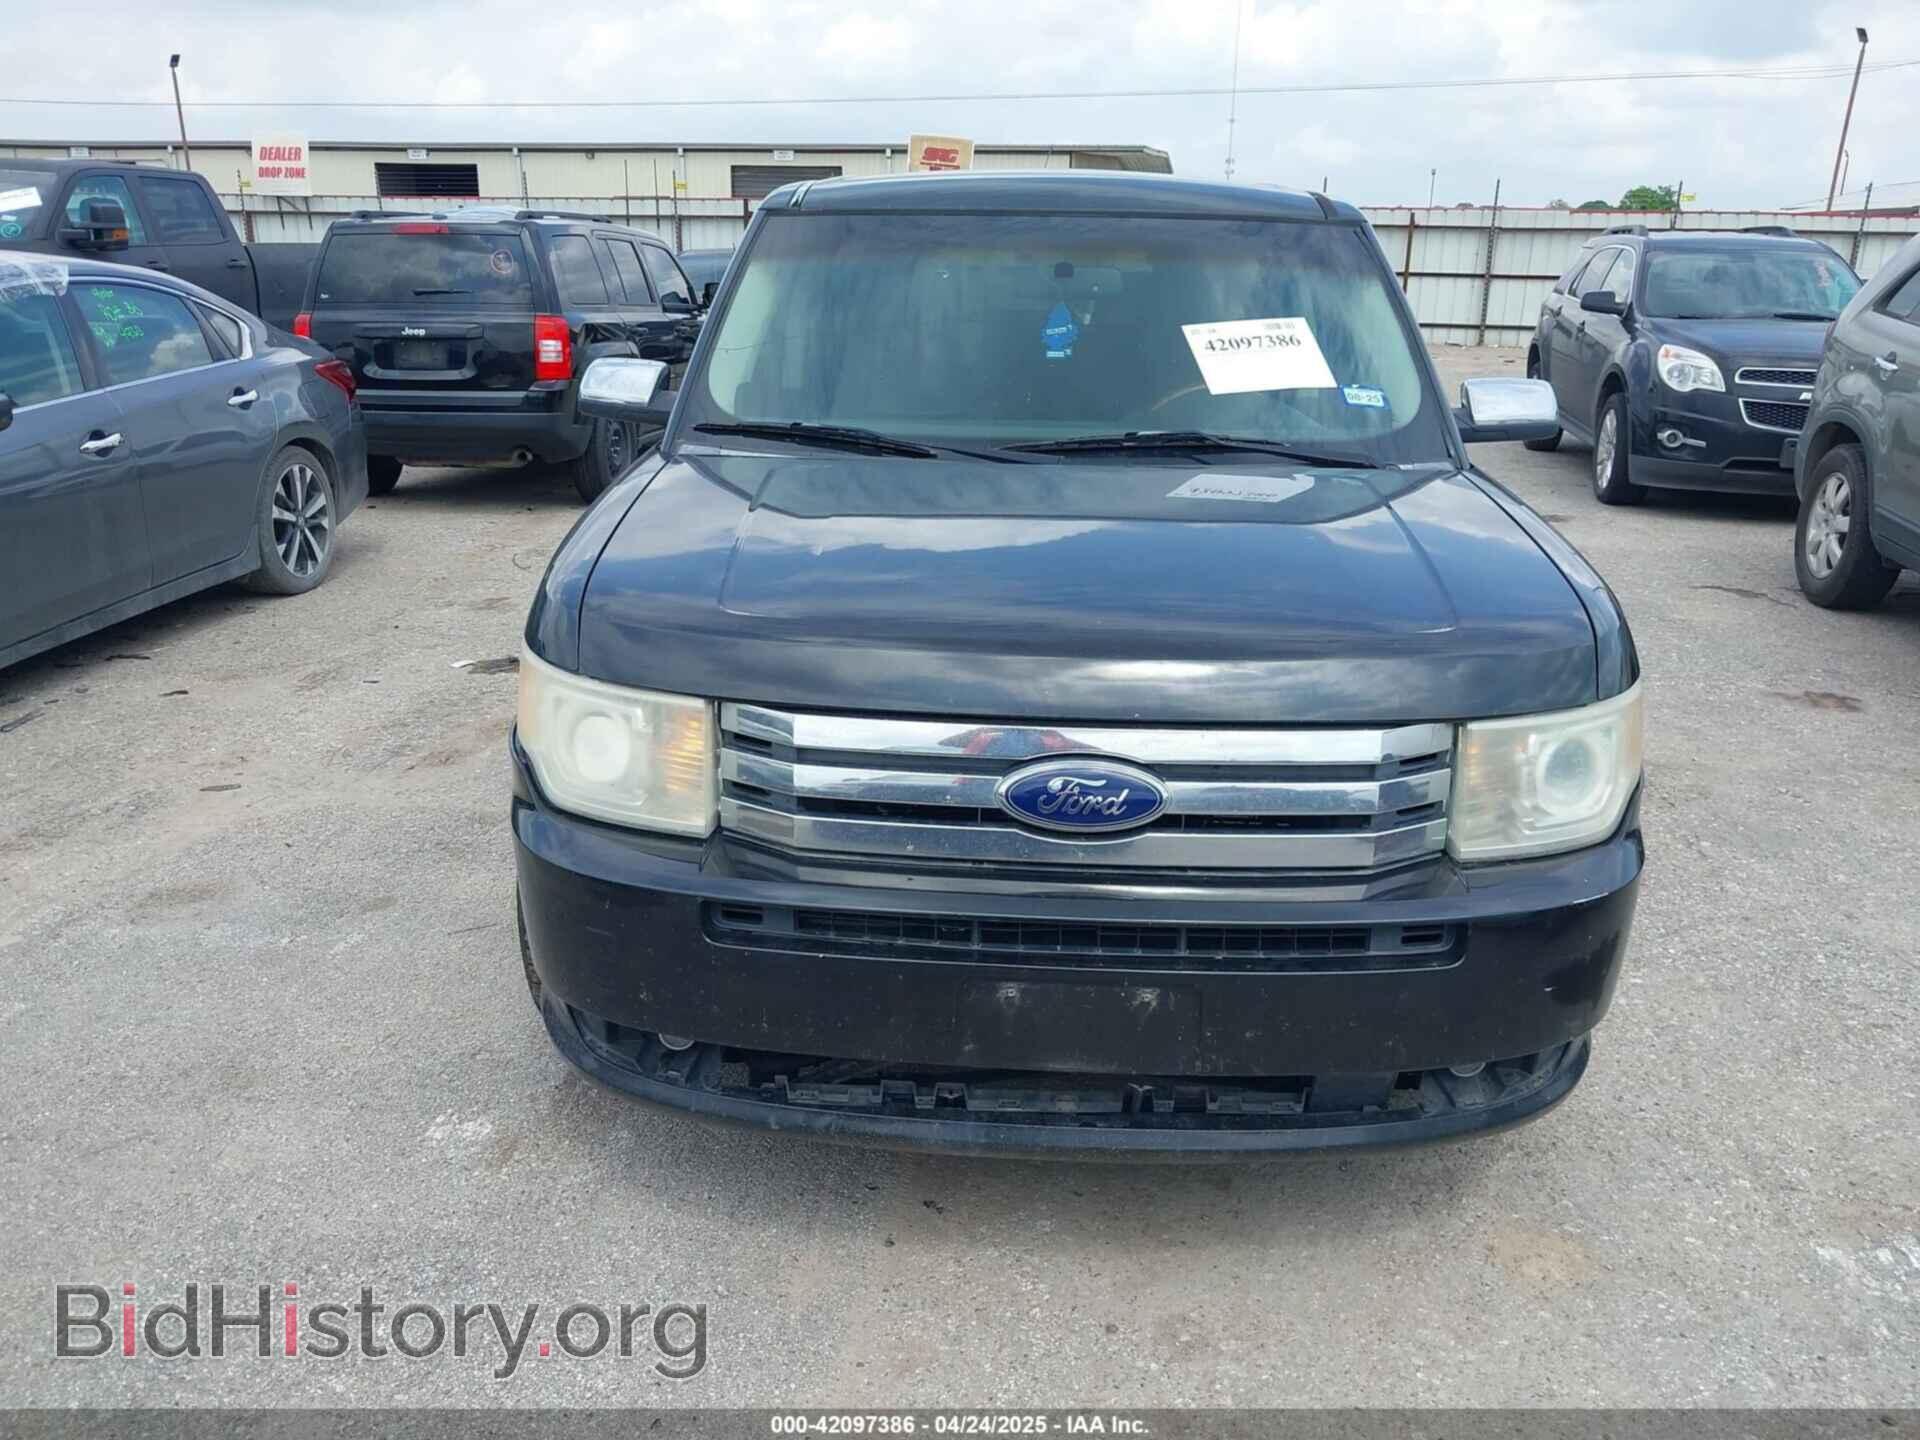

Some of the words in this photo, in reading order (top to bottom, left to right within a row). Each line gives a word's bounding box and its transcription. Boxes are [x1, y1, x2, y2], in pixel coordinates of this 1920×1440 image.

[259, 146, 302, 161] DEALER
[258, 166, 281, 178] DROP
[283, 167, 306, 178] ZONE
[401, 326, 426, 336] Jeep
[1204, 334, 1302, 352] 42097386
[1037, 776, 1131, 816] Ford
